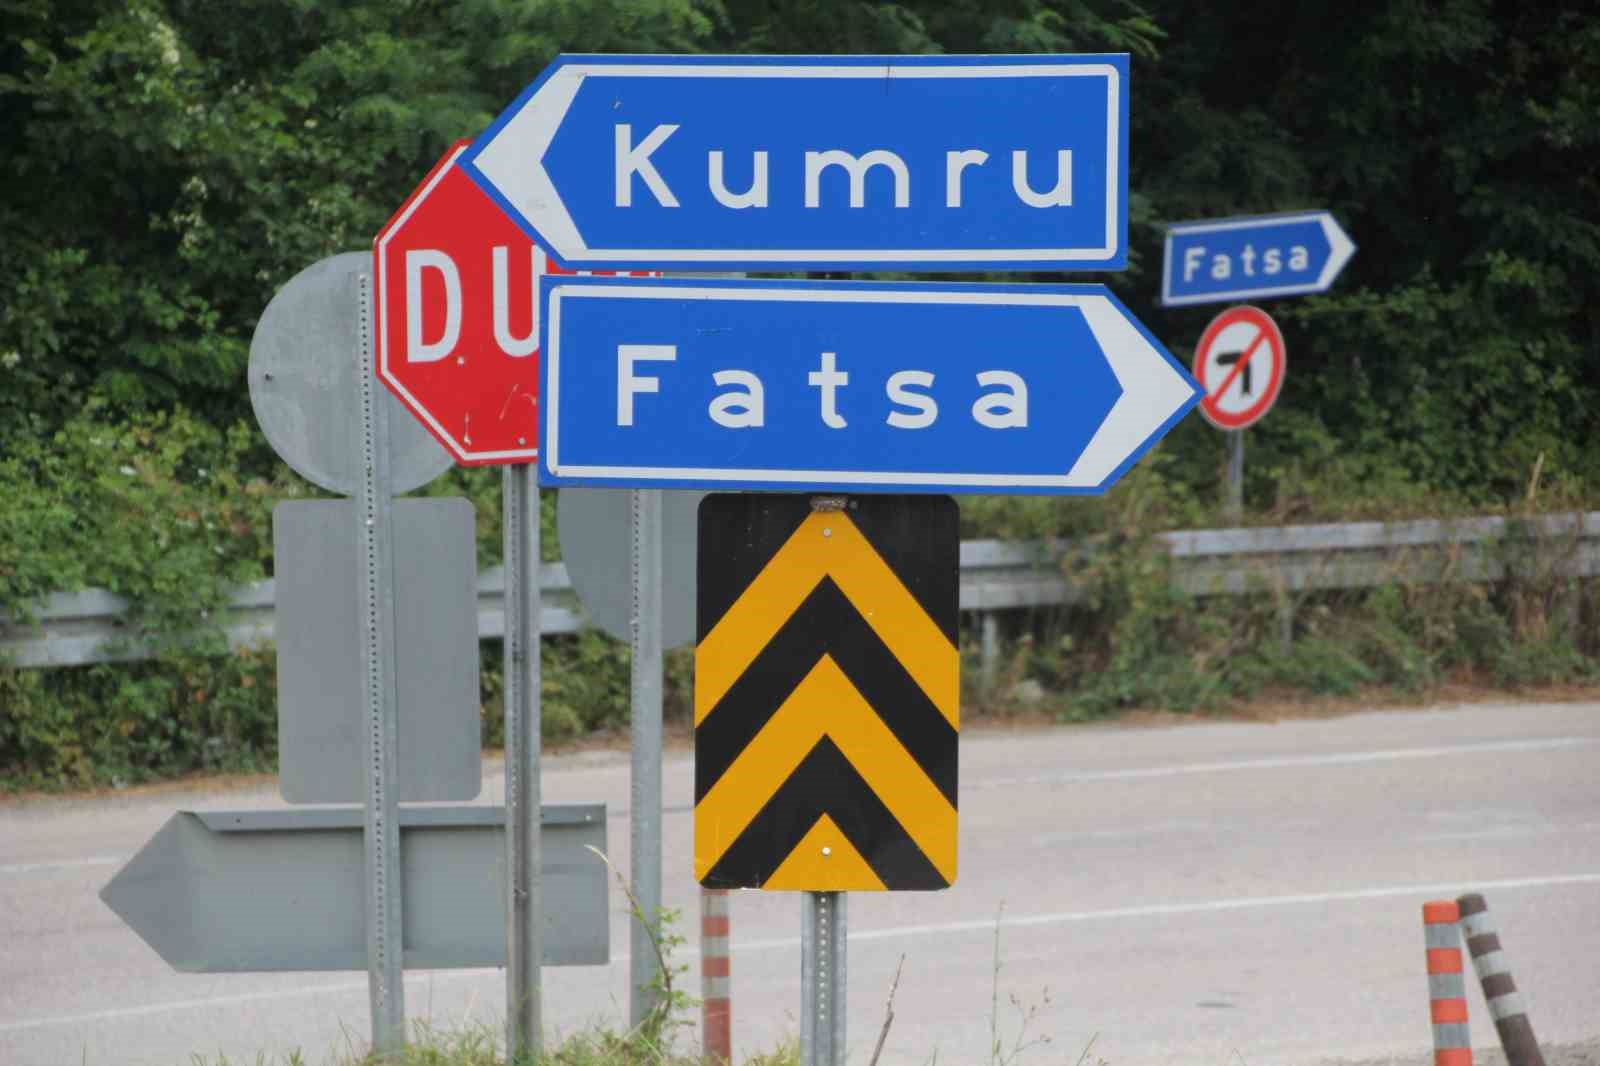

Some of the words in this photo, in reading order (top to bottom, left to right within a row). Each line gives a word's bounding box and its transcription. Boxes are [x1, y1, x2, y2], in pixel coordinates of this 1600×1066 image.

[615, 123, 1073, 209] Kumru
[405, 243, 631, 363] DU
[1183, 245, 1309, 283] Fatsa
[617, 344, 1029, 429] Fatsa
